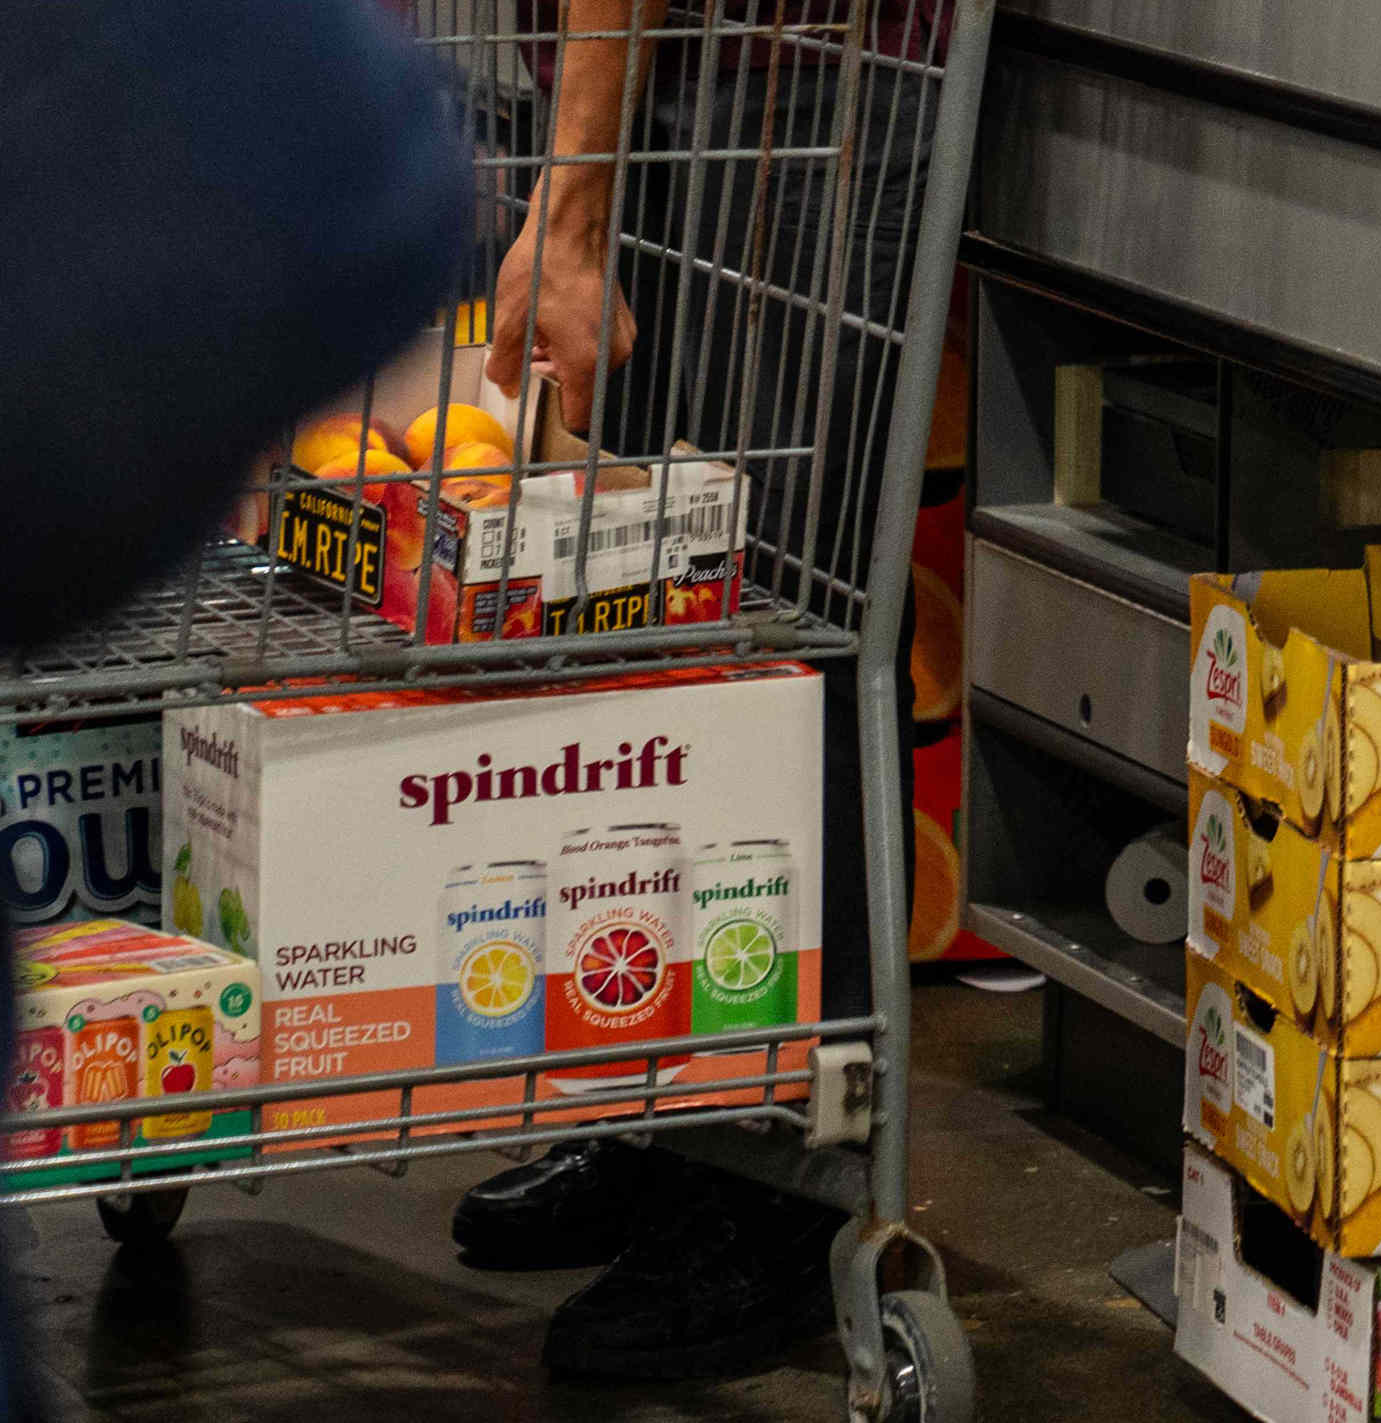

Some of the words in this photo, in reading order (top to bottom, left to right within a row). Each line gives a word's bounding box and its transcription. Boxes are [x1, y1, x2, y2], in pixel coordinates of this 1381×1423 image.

[1206, 648, 1243, 707] Zespri
[180, 726, 241, 779] spindrift
[400, 736, 690, 826] spindrift
[1201, 832, 1230, 893] Zespri
[559, 868, 680, 911] spindrift
[692, 875, 790, 910] spindrift
[447, 896, 547, 932] spindrift
[566, 906, 634, 959] SPARKLING
[639, 909, 675, 951] WATER
[275, 934, 418, 968] SPARKLING
[276, 965, 366, 993] WATER
[275, 1003, 342, 1030] REAL
[562, 978, 582, 1015] REAL
[582, 1005, 656, 1029] SQUEEZED
[274, 1022, 412, 1055] SQUEEZED
[274, 1051, 349, 1079] FRUIT
